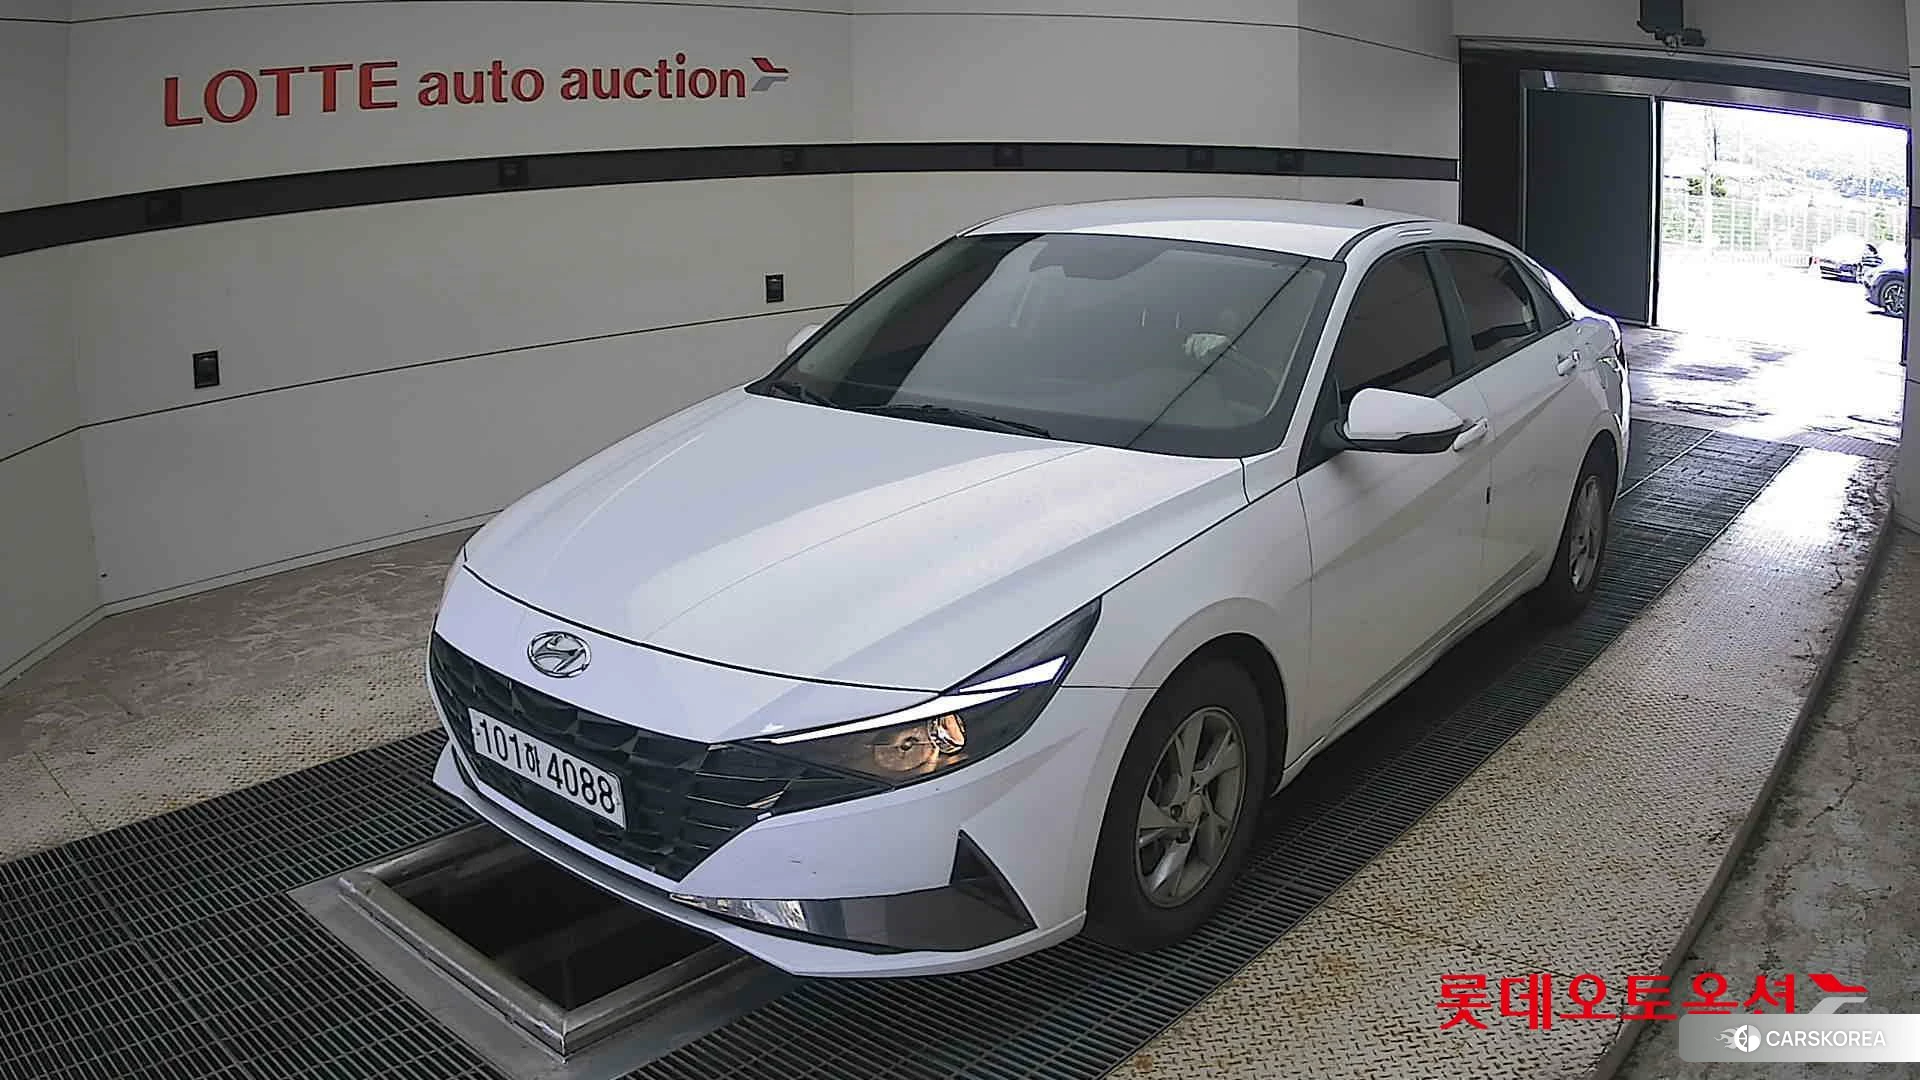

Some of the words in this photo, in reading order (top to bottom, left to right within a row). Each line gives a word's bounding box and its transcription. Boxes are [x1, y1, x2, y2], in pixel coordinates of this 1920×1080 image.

[164, 60, 399, 127] LOTTE
[417, 60, 546, 107] auto
[560, 52, 748, 101] auction
[546, 752, 616, 815] 4088
